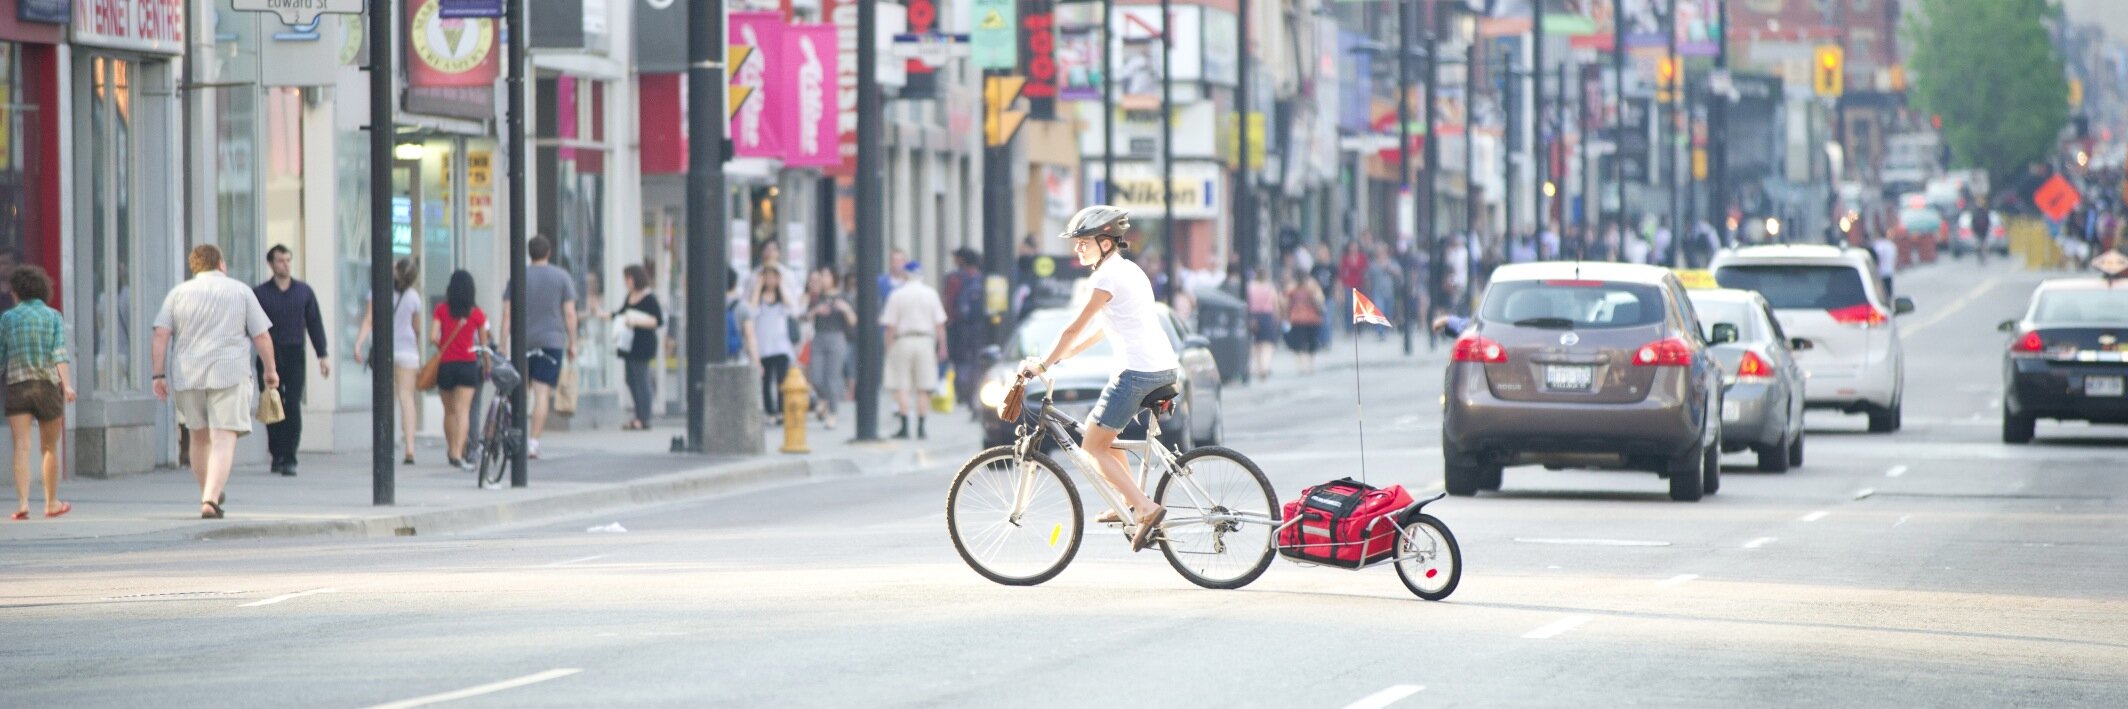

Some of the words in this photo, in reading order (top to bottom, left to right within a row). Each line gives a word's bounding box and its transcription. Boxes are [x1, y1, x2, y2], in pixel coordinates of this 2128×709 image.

[267, 0, 313, 9] Edward
[315, 0, 328, 9] St
[138, 0, 182, 42] CENTRE
